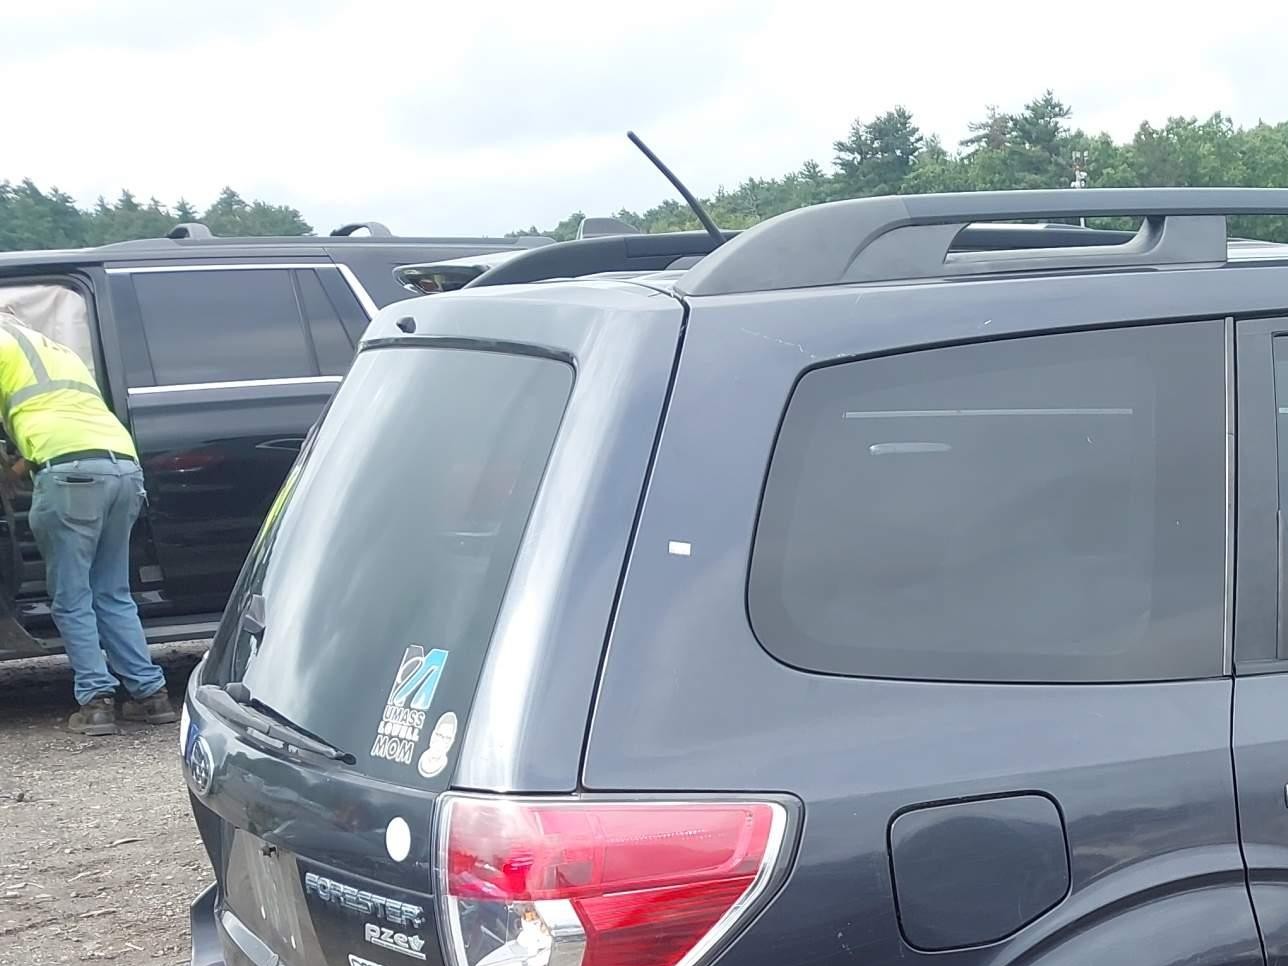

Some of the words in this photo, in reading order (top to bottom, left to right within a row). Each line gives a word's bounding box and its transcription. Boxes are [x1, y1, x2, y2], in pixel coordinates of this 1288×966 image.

[382, 704, 426, 729] UMASS
[377, 720, 420, 742] LOWELL
[370, 734, 415, 764] MOM
[305, 872, 424, 928] FORESTER
